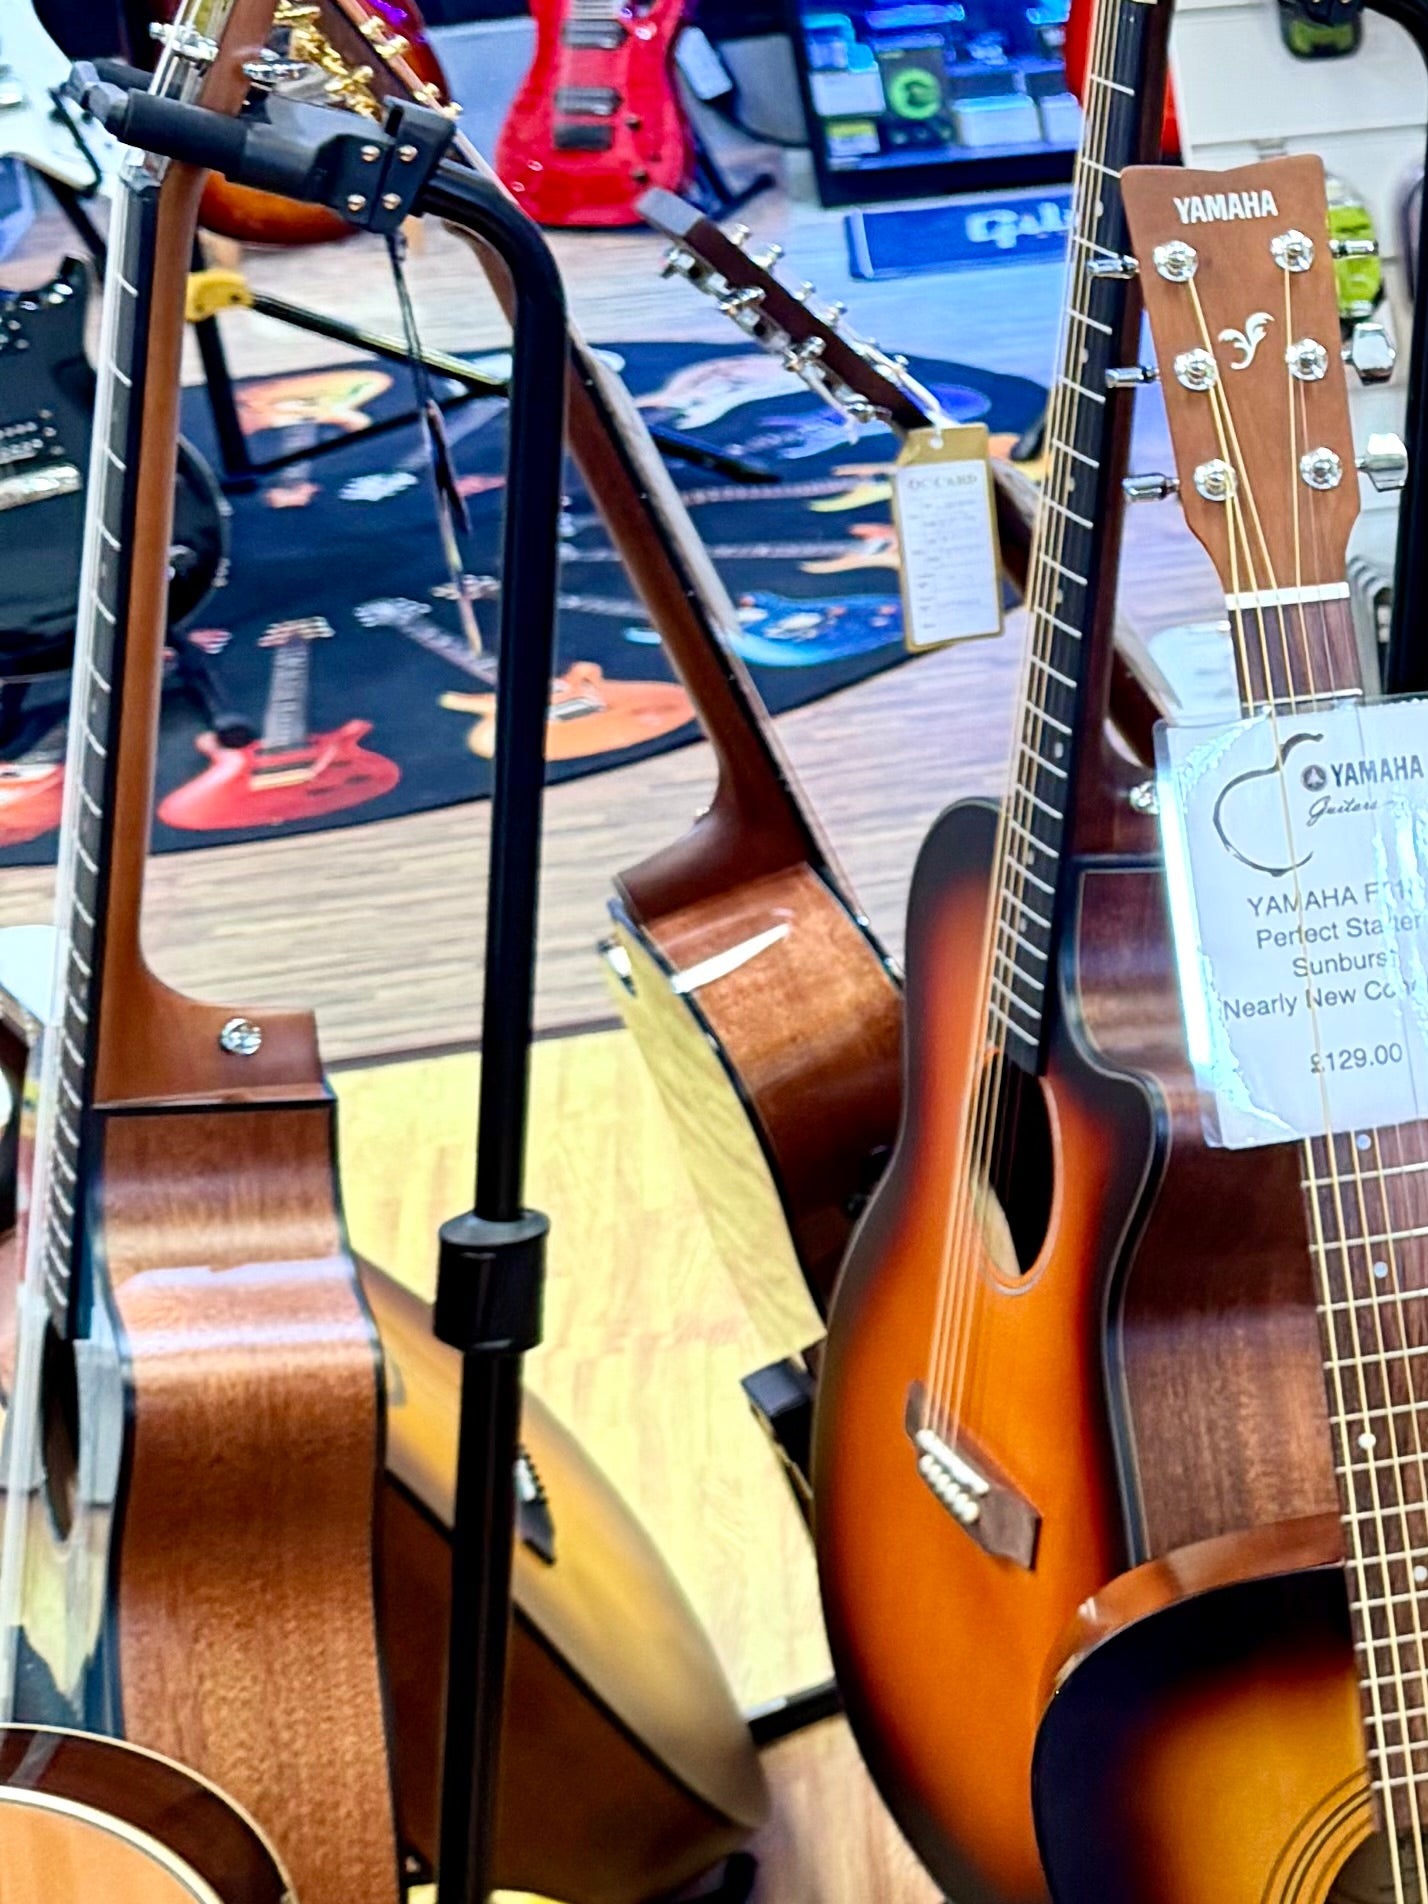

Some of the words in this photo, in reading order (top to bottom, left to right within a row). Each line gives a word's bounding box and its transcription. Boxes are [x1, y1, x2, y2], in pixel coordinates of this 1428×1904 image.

[1173, 189, 1279, 224] YAMAHA
[1330, 754, 1424, 788] YAMAHA
[1306, 796, 1380, 827] Guitars
[1247, 883, 1358, 917] YAMAHA
[1256, 921, 1340, 949] Perfect
[1346, 913, 1421, 939] Stater
[1222, 992, 1297, 1020] Nearly
[1306, 988, 1356, 1009] New
[1310, 1043, 1403, 1074] £129.00
